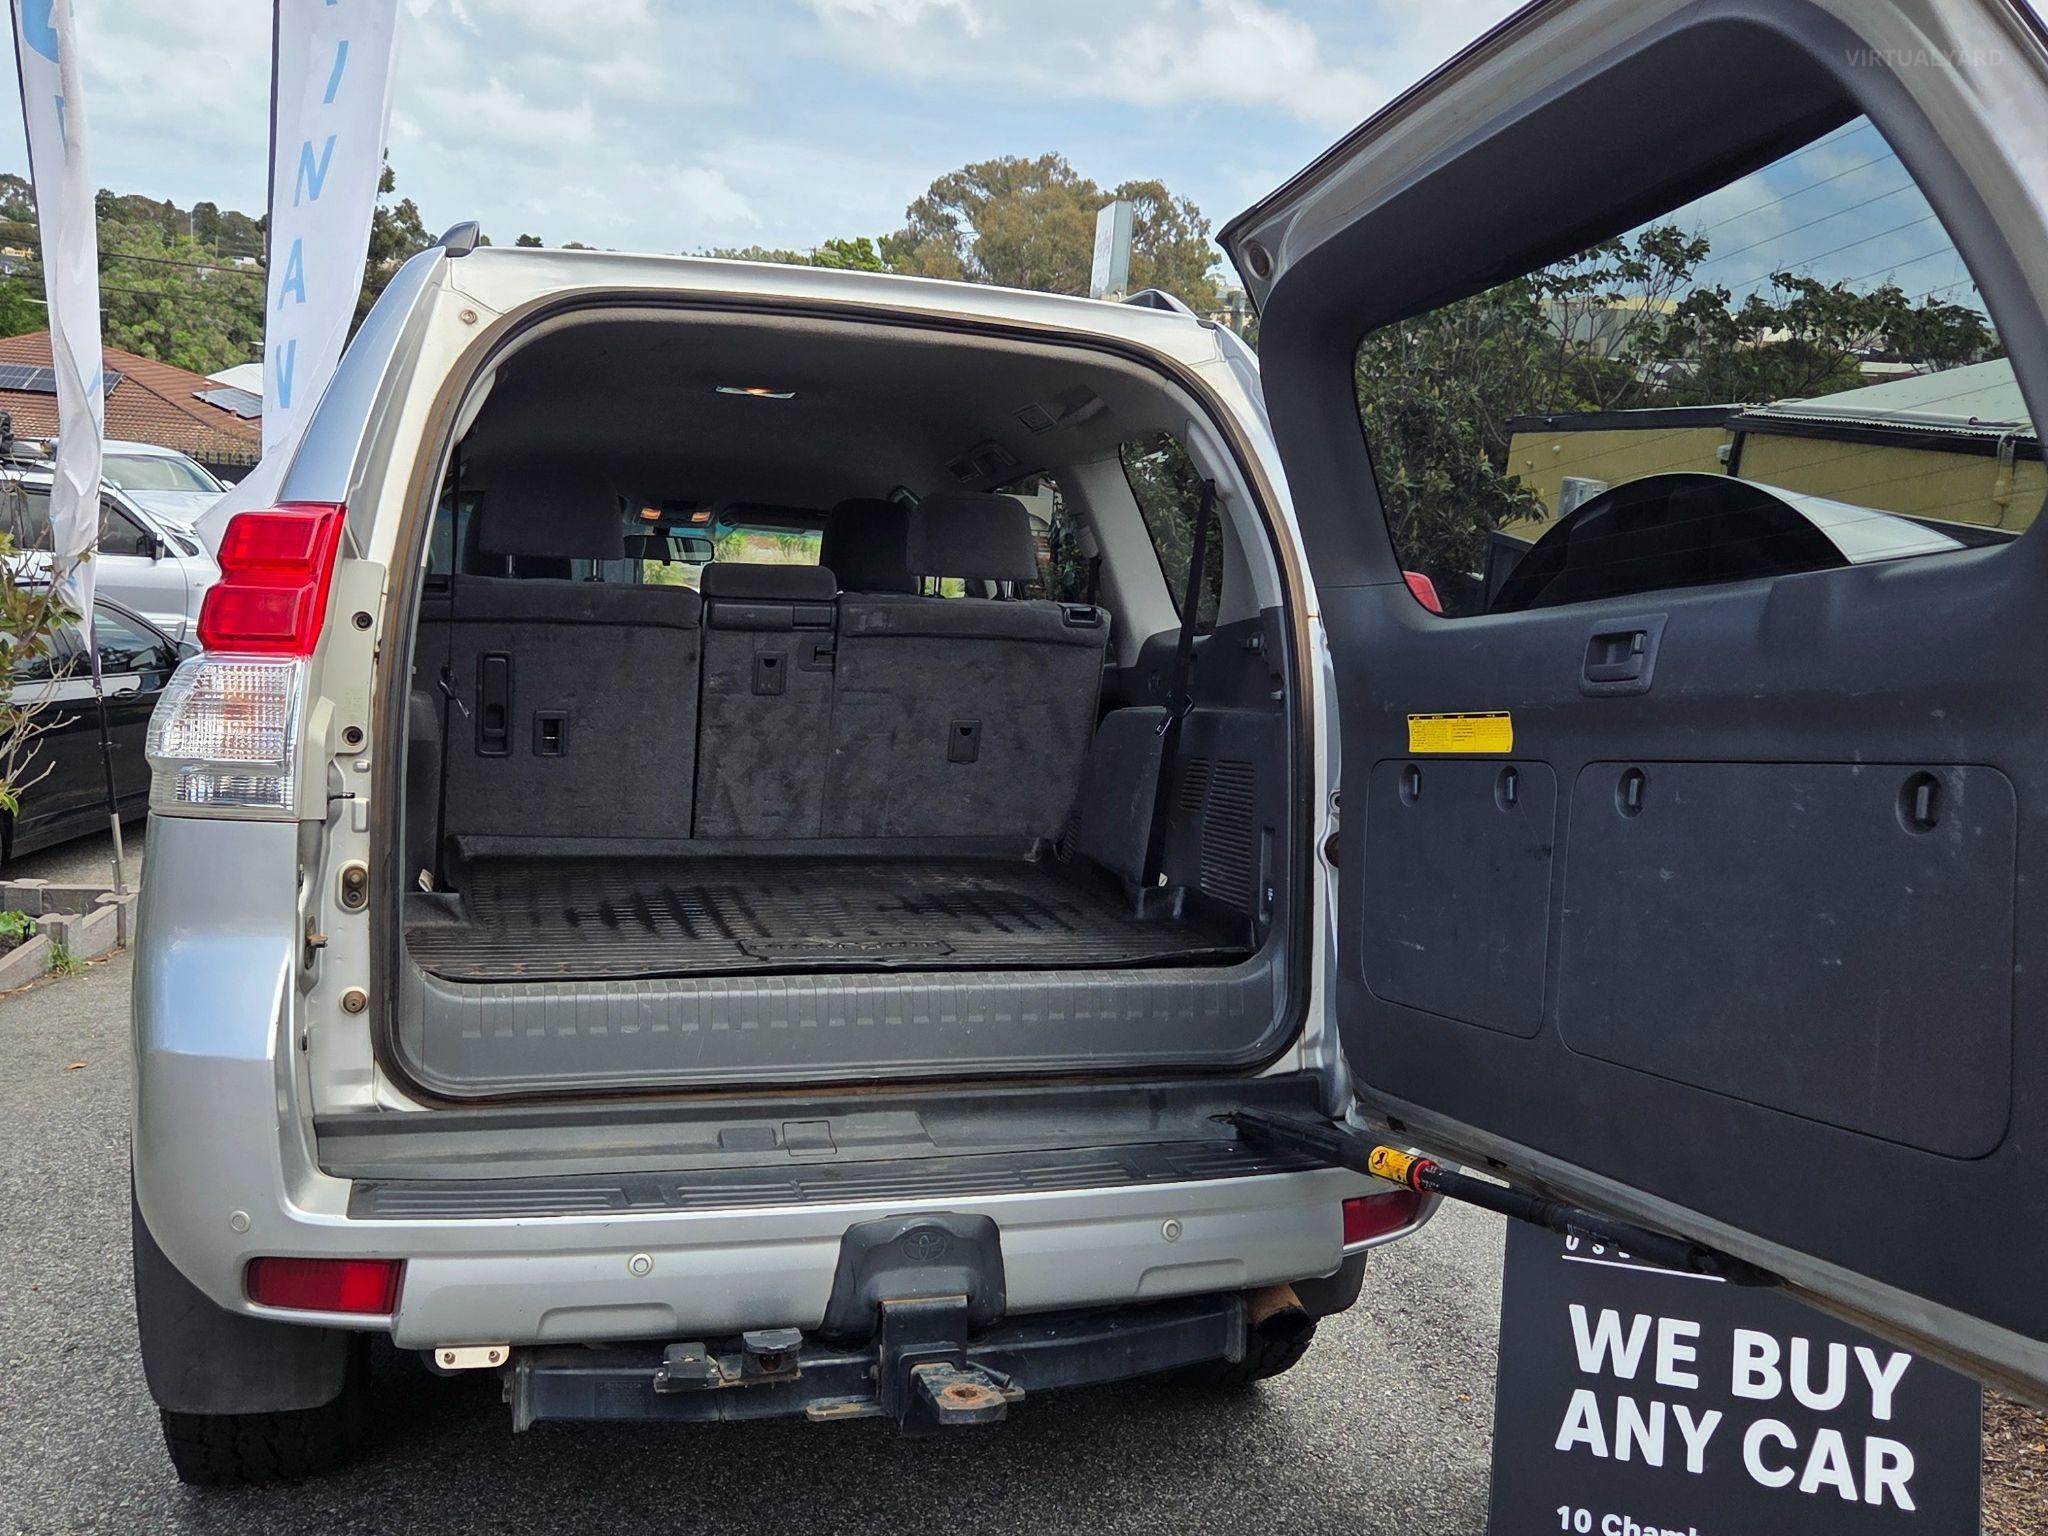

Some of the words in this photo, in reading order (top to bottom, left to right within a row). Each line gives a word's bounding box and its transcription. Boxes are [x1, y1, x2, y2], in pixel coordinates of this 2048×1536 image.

[1568, 1303, 1701, 1390] WE
[1731, 1328, 1912, 1421] BUY
[1554, 1388, 1723, 1474] ANY
[1743, 1418, 1916, 1512] CAR
[1556, 1505, 1592, 1534] 10
